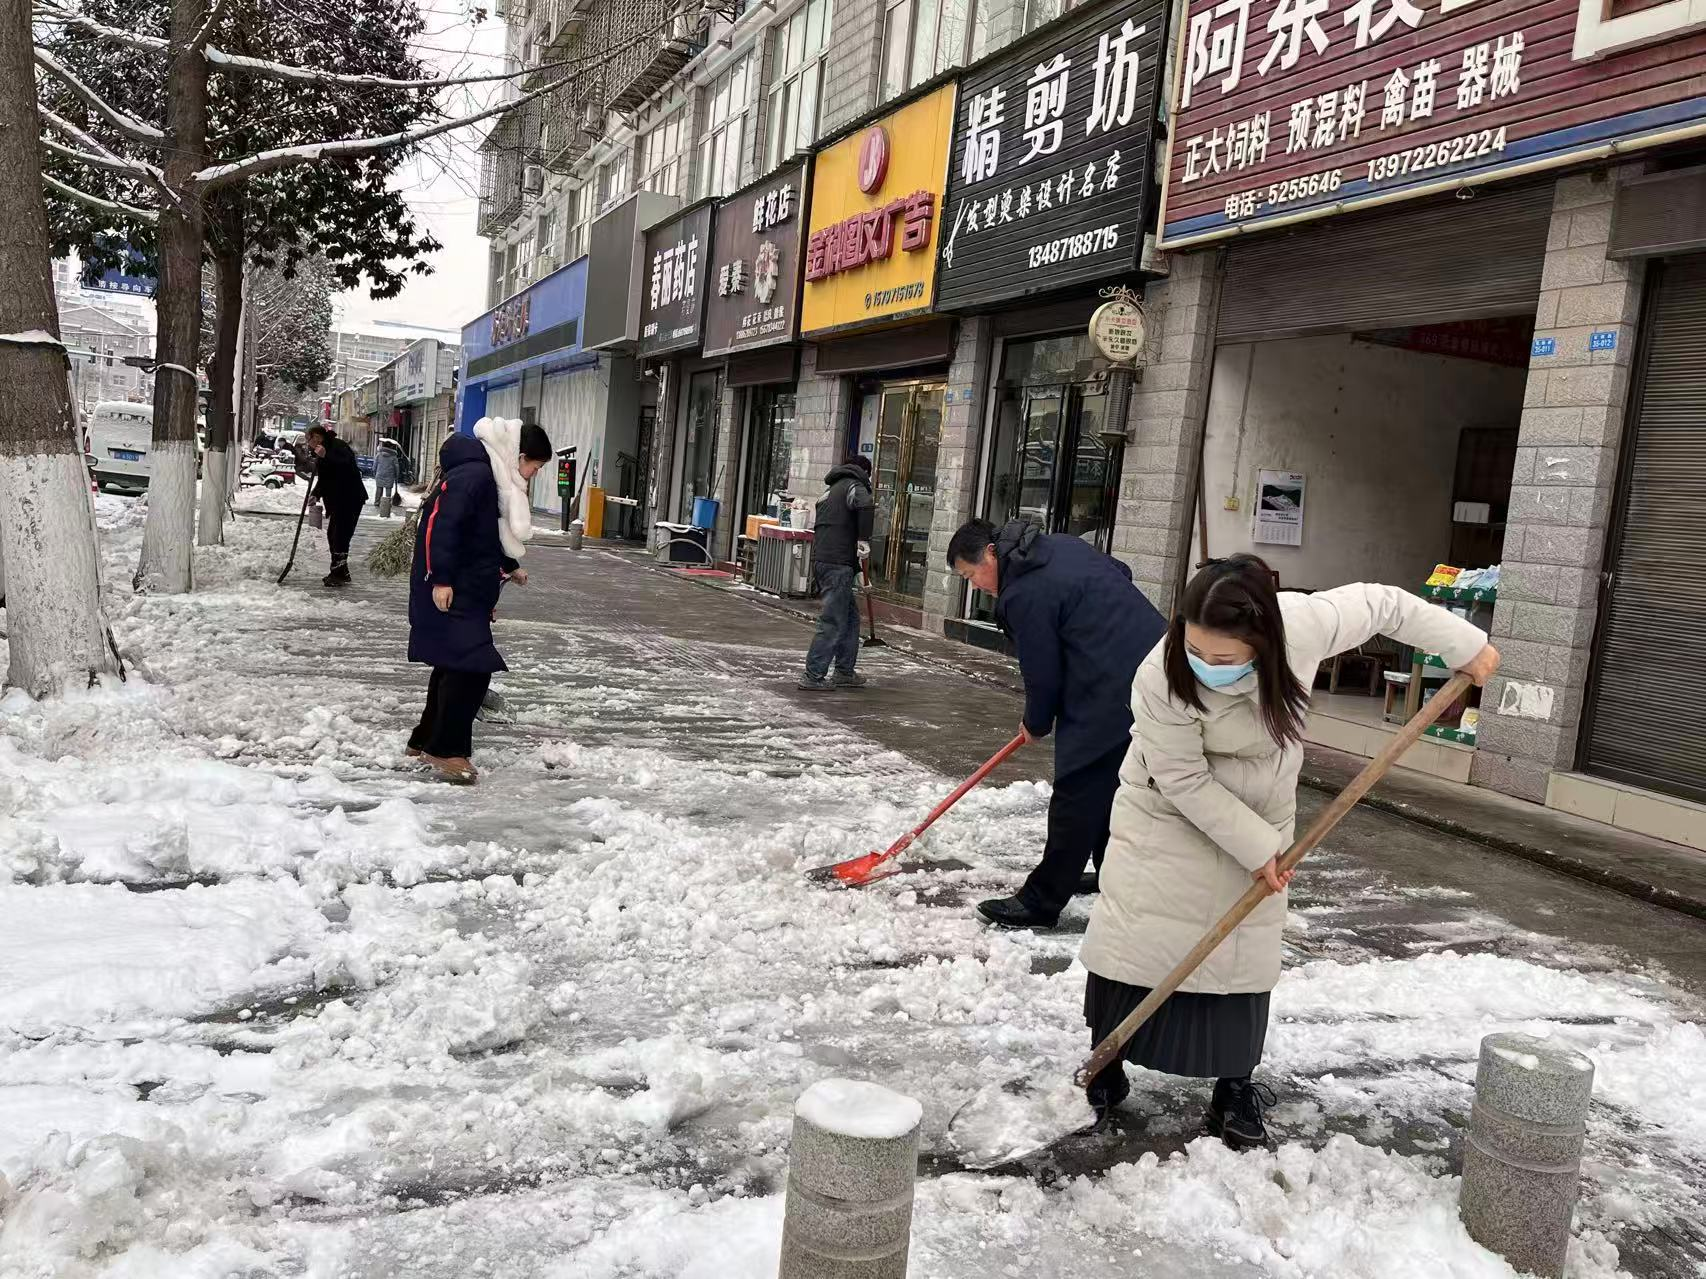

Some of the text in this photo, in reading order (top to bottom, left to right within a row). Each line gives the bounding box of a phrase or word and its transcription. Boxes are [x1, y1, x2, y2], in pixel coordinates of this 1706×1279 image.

[961, 18, 1146, 185] 精剪坊
[1181, 31, 1526, 184] 正大饲料 预混料 禽苗 器械
[1366, 125, 1508, 184] 13972262224
[751, 183, 793, 234] 鲜花店
[1028, 224, 1119, 268] 13487188715
